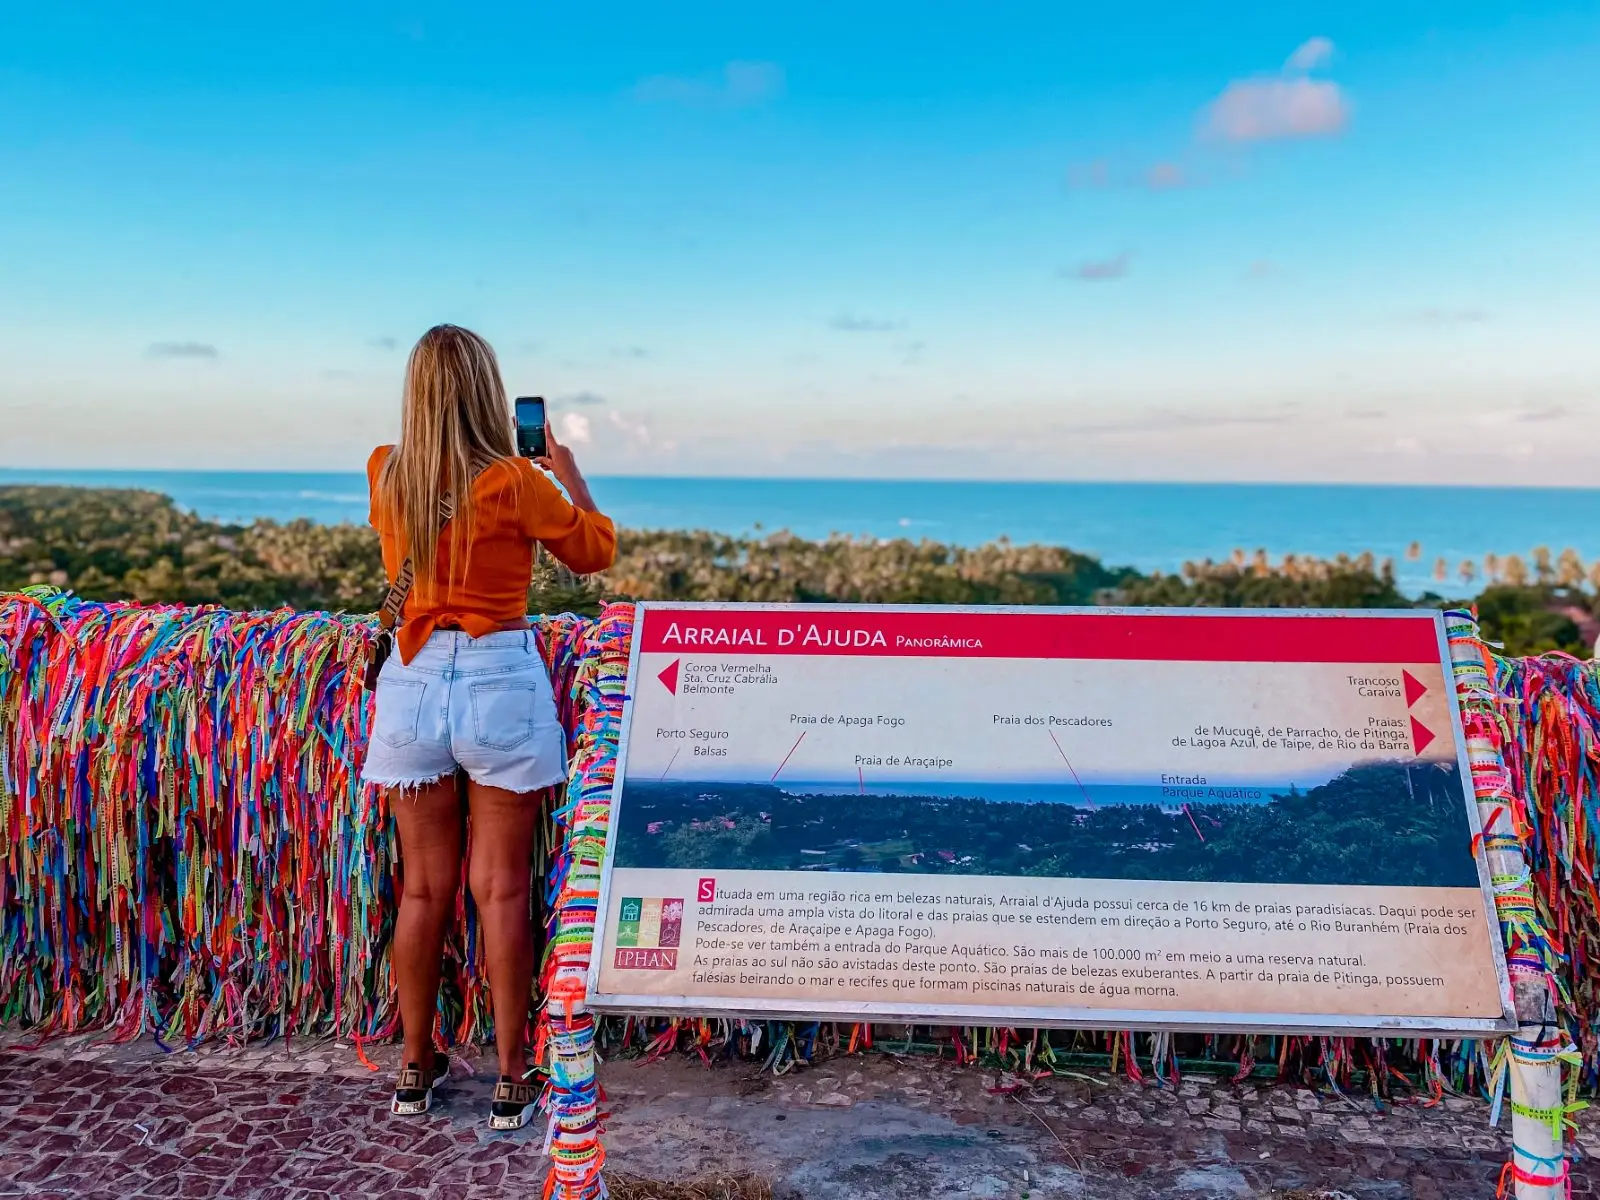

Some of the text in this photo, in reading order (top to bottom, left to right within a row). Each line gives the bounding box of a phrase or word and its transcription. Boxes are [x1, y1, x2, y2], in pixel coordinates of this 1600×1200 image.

[685, 663, 771, 673] Coroa Vermelha
[684, 673, 778, 685] Sta. Cruz Cabrália
[1347, 676, 1399, 687] Trancoso
[683, 684, 735, 695] Belmonte
[790, 714, 904, 728] Praia de Apaga Fogo
[994, 715, 1112, 726] Praia dos Pescadores
[1368, 717, 1406, 728] Praias:
[657, 728, 728, 741] Porto Seguro
[1195, 725, 1209, 737] de
[1267, 727, 1283, 737] de
[1287, 727, 1341, 740] Parracho,
[1345, 727, 1360, 739] de
[1364, 728, 1408, 742] Pitinga,
[1172, 736, 1187, 747] de
[1191, 737, 1226, 750] Lagoa
[1262, 737, 1277, 749] de
[1317, 739, 1333, 750] de
[1337, 739, 1356, 750] Rio
[1360, 739, 1375, 750] da
[1378, 739, 1410, 750] Barra
[694, 746, 727, 756] Balsas
[855, 755, 882, 766] Praia
[886, 756, 900, 766] de
[1162, 774, 1206, 785] Entrada
[1162, 787, 1261, 801] Parque Aquático
[756, 892, 775, 902] em
[779, 892, 804, 903] uma
[808, 889, 846, 907] região
[849, 891, 871, 904] rica
[874, 895, 893, 905] em
[896, 891, 941, 906] belezas
[945, 893, 996, 909] naturais,
[999, 894, 1039, 908] Arraial
[1042, 895, 1089, 913] d'Ajuda
[1093, 897, 1133, 914] possui
[1136, 901, 1169, 912] cerca
[1172, 898, 1189, 912] de
[1193, 899, 1208, 912] 16
[1211, 899, 1231, 913] km
[1234, 899, 1251, 913] de
[1254, 901, 1292, 918] praias
[1295, 901, 1376, 920] paradisíacas.
[1378, 903, 1417, 921] Daqui
[1420, 904, 1454, 921] pode
[1457, 909, 1476, 919] ser
[698, 903, 754, 918] admirada
[758, 908, 784, 919] uma
[788, 905, 825, 923] ampla
[828, 907, 855, 921] vista
[858, 907, 877, 921] do
[878, 908, 913, 922] litoral
[916, 912, 924, 922] e
[927, 909, 949, 923] das
[952, 910, 989, 927] praias
[991, 914, 1016, 928] que
[1018, 915, 1032, 925] se
[1036, 911, 1097, 926] estendem
[1100, 917, 1120, 927] em
[1124, 913, 1170, 931] direção
[1171, 918, 1181, 928] a
[1185, 915, 1219, 929] Porto
[1222, 916, 1271, 934] Seguro,
[1274, 917, 1295, 931] até
[1298, 921, 1307, 931] o
[1310, 918, 1331, 932] Rio
[1334, 918, 1400, 934] Buranhém
[1443, 921, 1467, 935] dos
[697, 920, 766, 937] Pescadores,
[770, 921, 785, 935] de
[844, 927, 852, 937] e
[855, 923, 895, 941] Apaga
[616, 950, 674, 967] IPHAN
[696, 936, 744, 951] Pode-se
[747, 941, 767, 952] ver
[770, 938, 820, 953] também
[823, 943, 831, 953] a
[834, 940, 881, 954] entrada
[884, 941, 901, 955] do
[905, 941, 948, 959] Parque
[950, 943, 1009, 961] Aquático.
[1013, 944, 1036, 958] São
[1040, 946, 1069, 959] mais
[1072, 946, 1088, 960] de
[1092, 946, 1141, 961] 100.000
[1165, 952, 1186, 962] em
[1189, 949, 1222, 963] meio
[1225, 953, 1233, 963] a
[1236, 954, 1265, 964] uma
[1268, 954, 1314, 965] reserva
[1318, 952, 1366, 967] natural.
[693, 952, 1445, 989] As praias ao sul não são avistadas deste ponto. São praias de belezas exuberantes. A partir da praia de Pitinga, possuem
[692, 970, 1179, 999] falésias beirando o mar e recifes que formam piscinas naturais de água morna.
